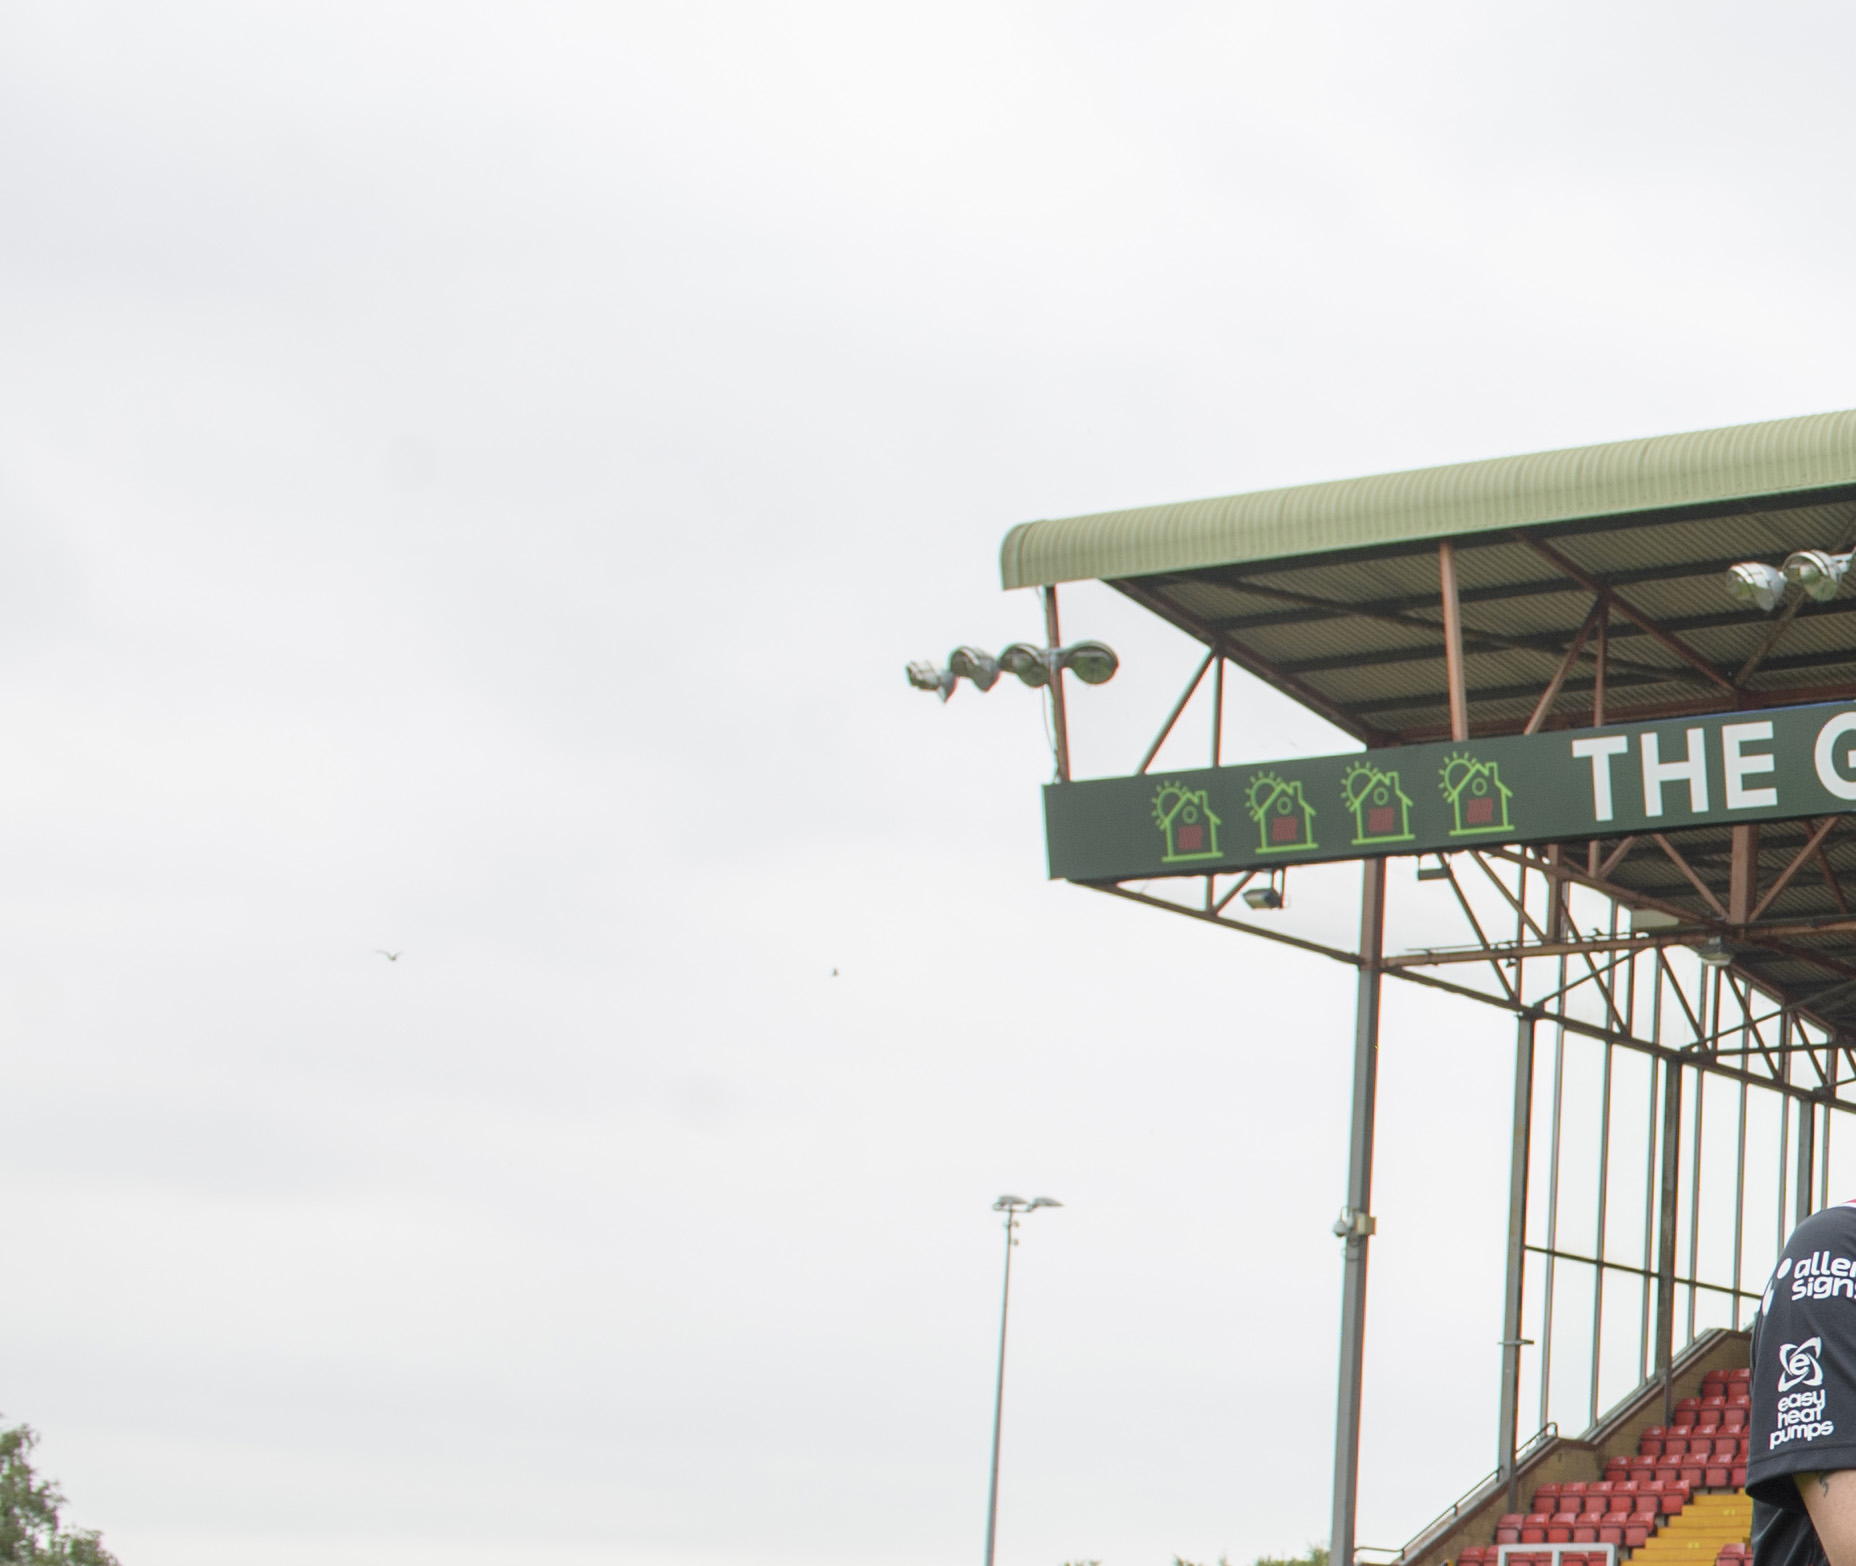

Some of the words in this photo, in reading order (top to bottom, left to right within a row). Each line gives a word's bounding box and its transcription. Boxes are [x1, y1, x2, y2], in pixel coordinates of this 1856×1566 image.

[1572, 721, 1778, 821] THE
[1777, 1389, 1826, 1412] easy
[1777, 1403, 1824, 1429] heat
[1769, 1420, 1835, 1450] pumps
